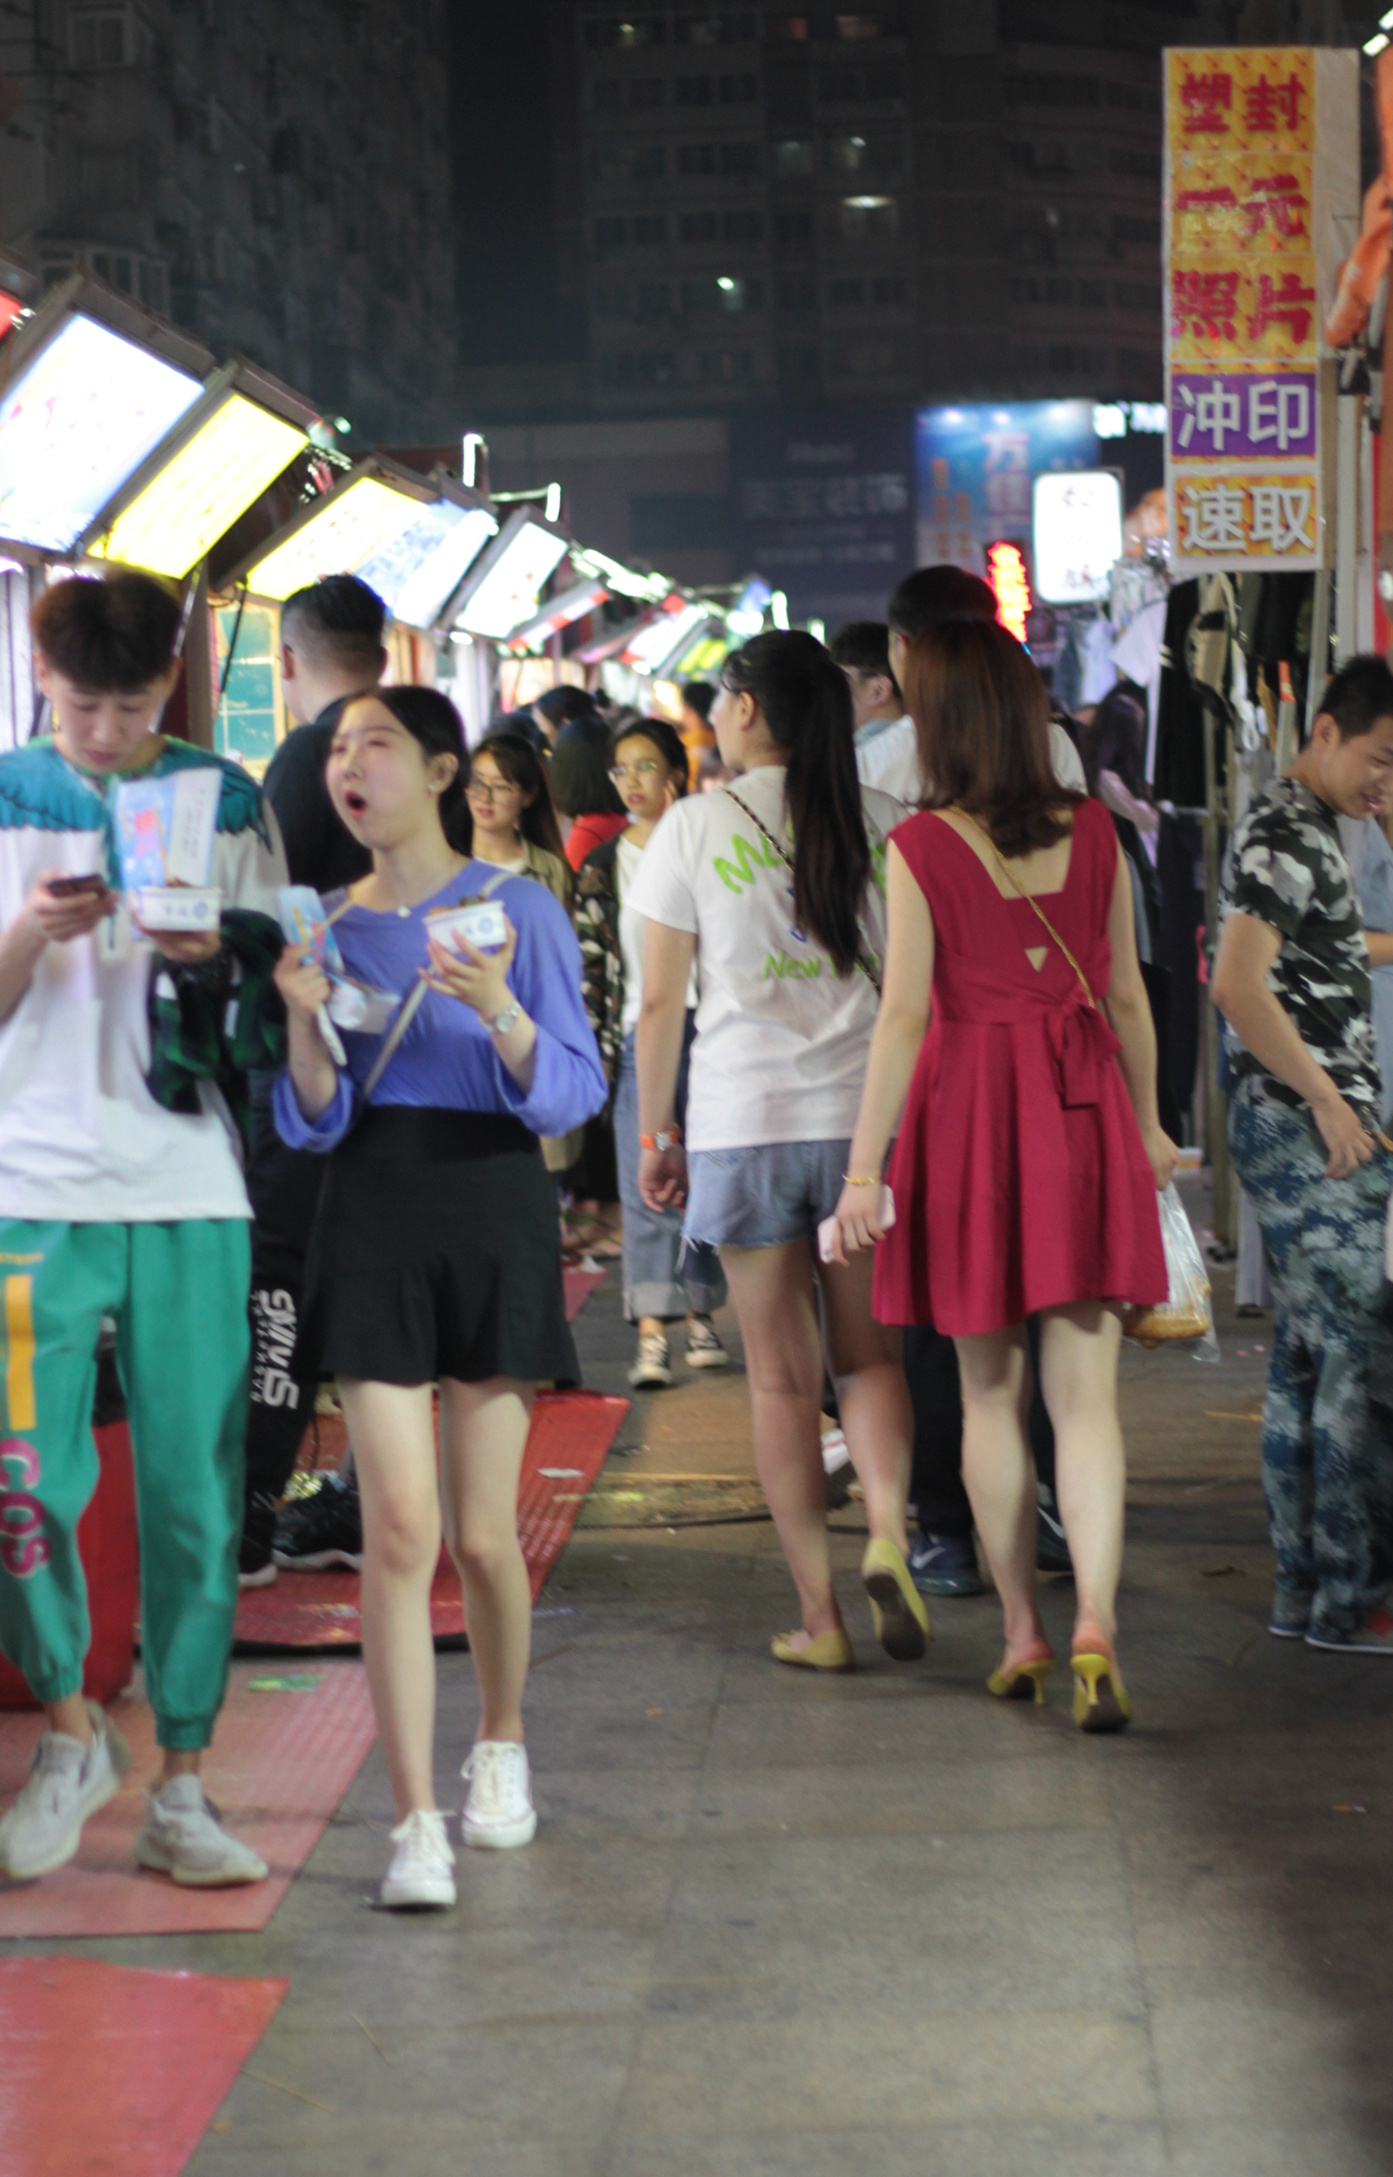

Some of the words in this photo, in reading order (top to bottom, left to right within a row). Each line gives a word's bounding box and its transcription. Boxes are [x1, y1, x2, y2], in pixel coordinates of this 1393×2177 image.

[1179, 71, 1307, 134] 塑封
[1174, 172, 1310, 237] 一元
[1171, 269, 1316, 345] 照片
[1177, 379, 1310, 451] 冲印
[1181, 482, 1314, 552] 速取
